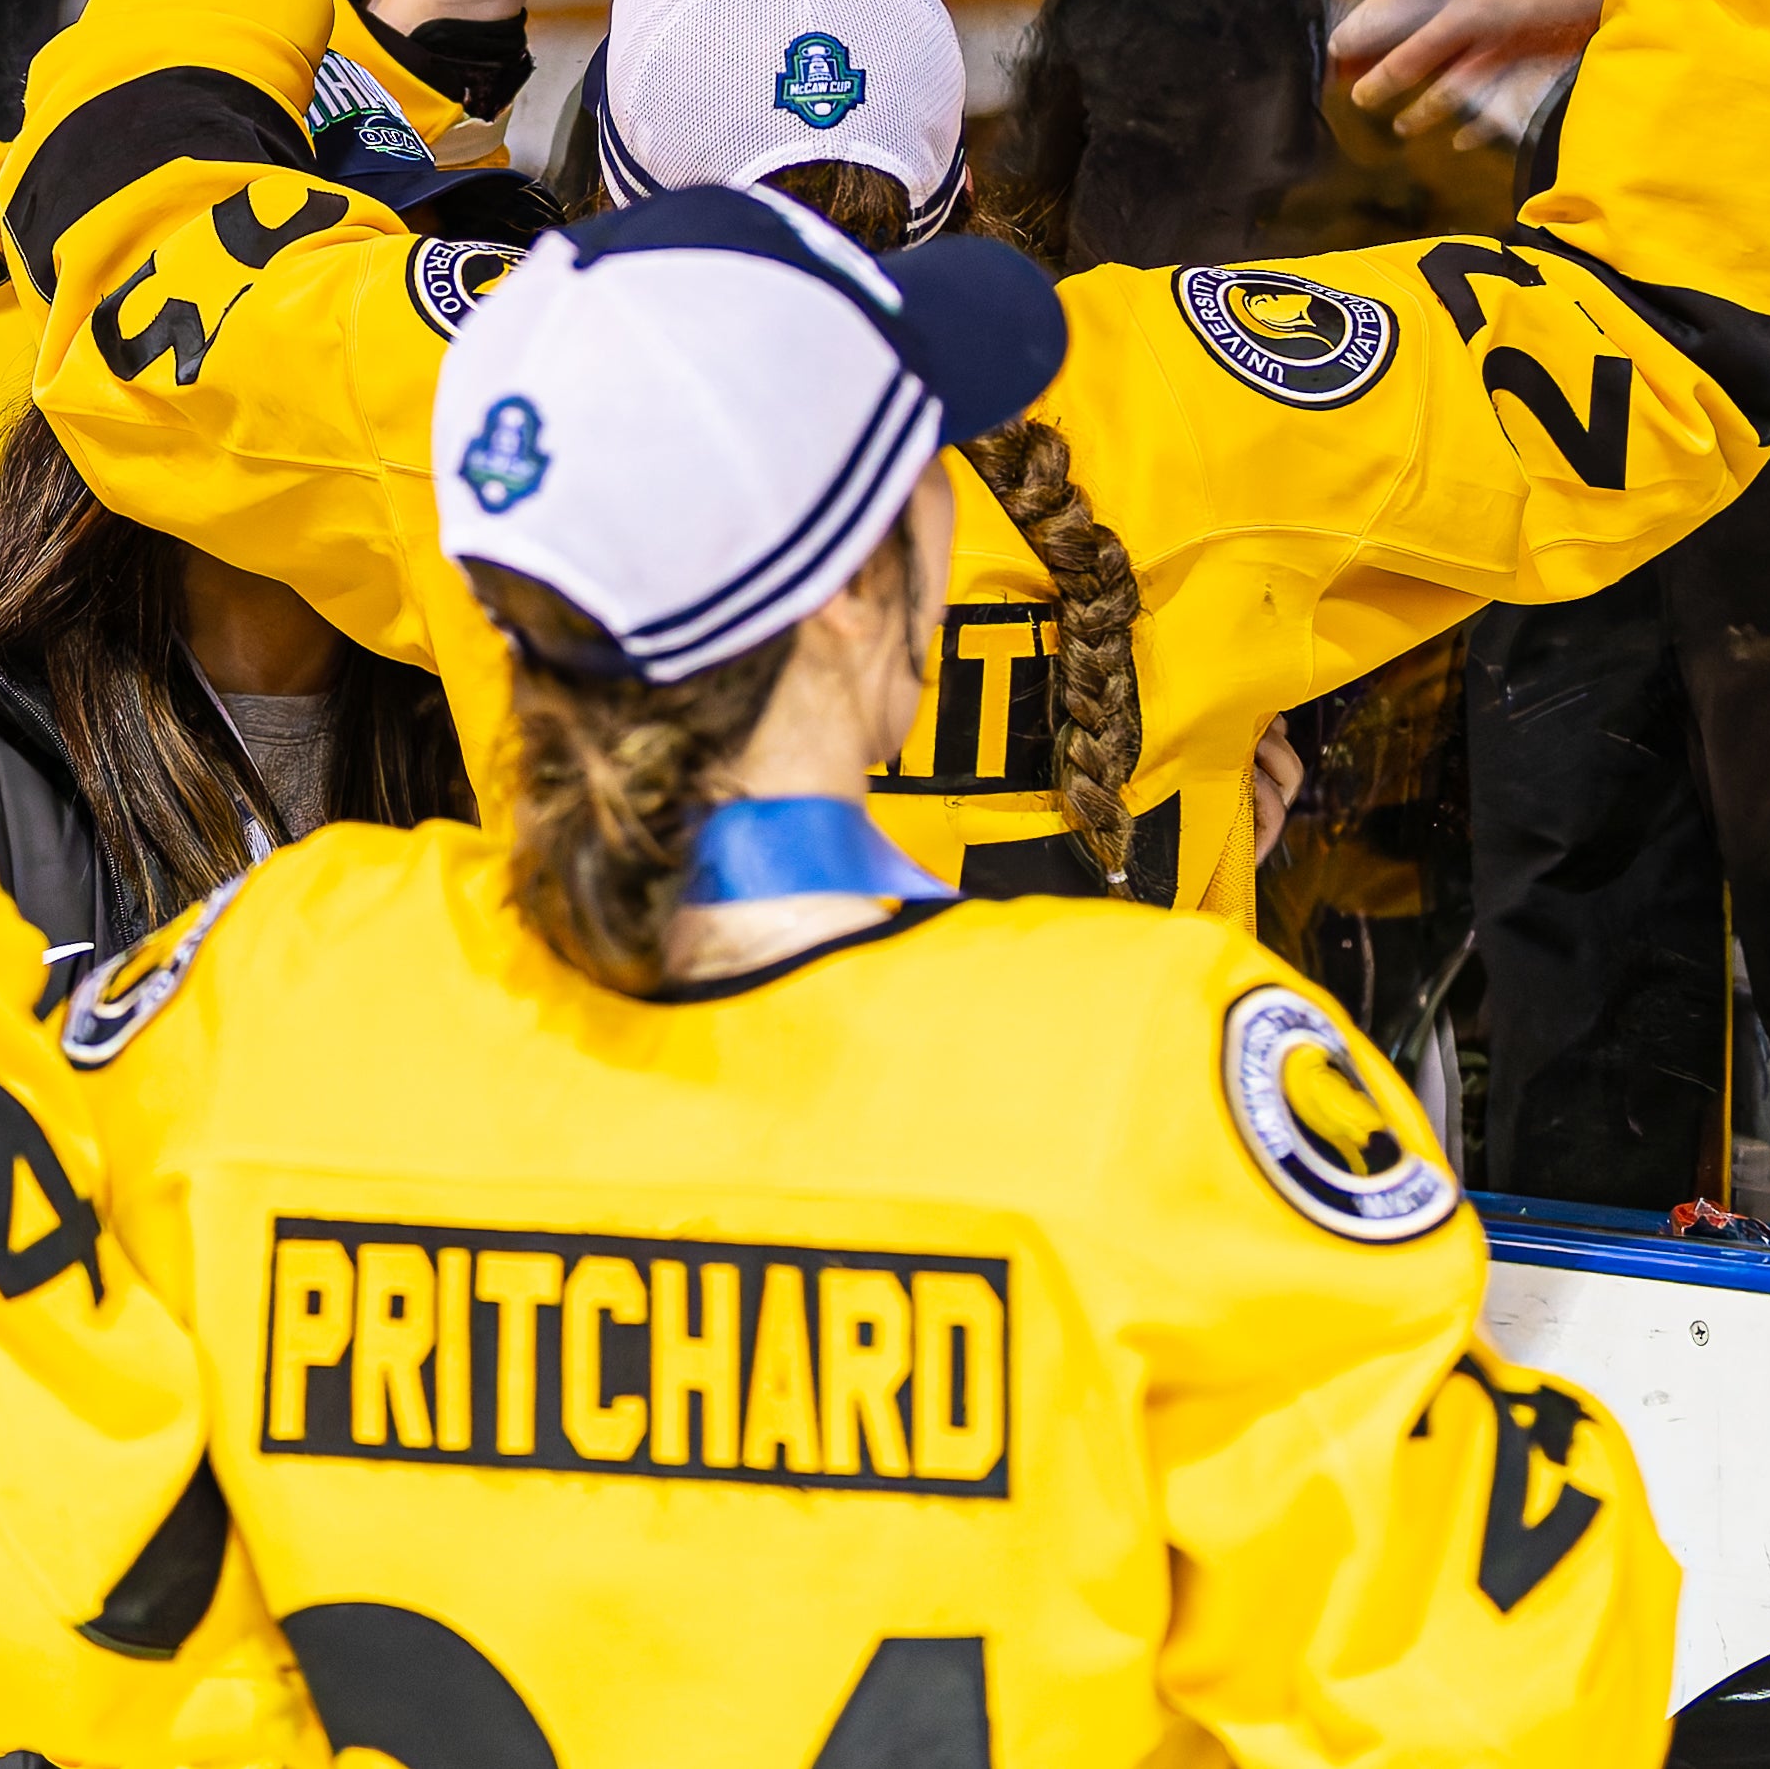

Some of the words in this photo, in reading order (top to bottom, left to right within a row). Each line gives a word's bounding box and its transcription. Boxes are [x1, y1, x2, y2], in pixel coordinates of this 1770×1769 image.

[789, 82, 829, 96] McCAW
[829, 80, 852, 94] CUP
[1191, 274, 1285, 384] UNIVERSITY
[267, 1237, 1007, 1480] PRITCHARD
